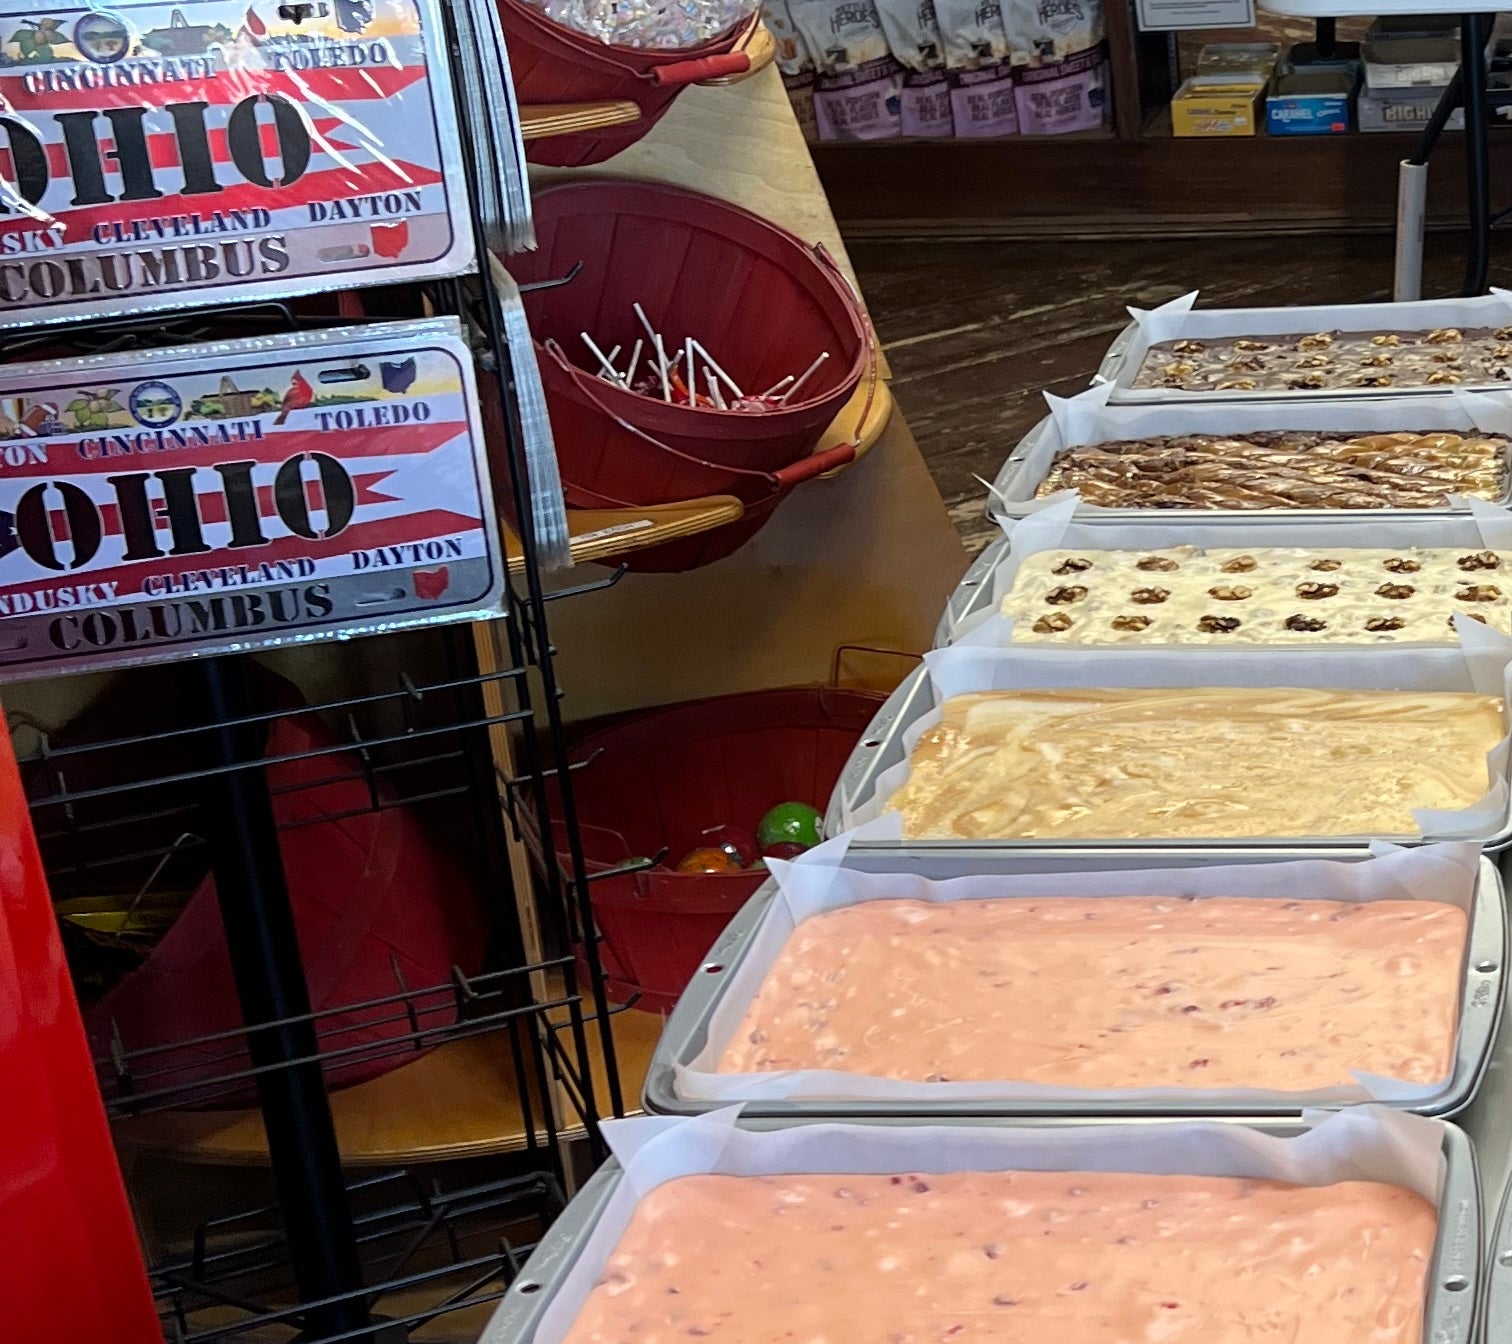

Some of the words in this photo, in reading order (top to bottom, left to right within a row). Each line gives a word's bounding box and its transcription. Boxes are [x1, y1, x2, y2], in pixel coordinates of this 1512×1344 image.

[24, 57, 217, 94] CINCINNATI
[272, 41, 388, 71] TOLEDO
[0, 92, 312, 216] OHIO
[92, 207, 272, 245] CLEVELAND
[308, 191, 423, 223] DAYTON
[0, 235, 291, 302] COLUMBUS
[78, 419, 264, 459] CINCINNATI
[315, 400, 431, 433] TOLEDO
[16, 452, 355, 570] OHIO
[143, 557, 316, 597] CLEVELAND
[352, 537, 463, 571] DAYTON
[48, 583, 334, 651] COLUMBUS
